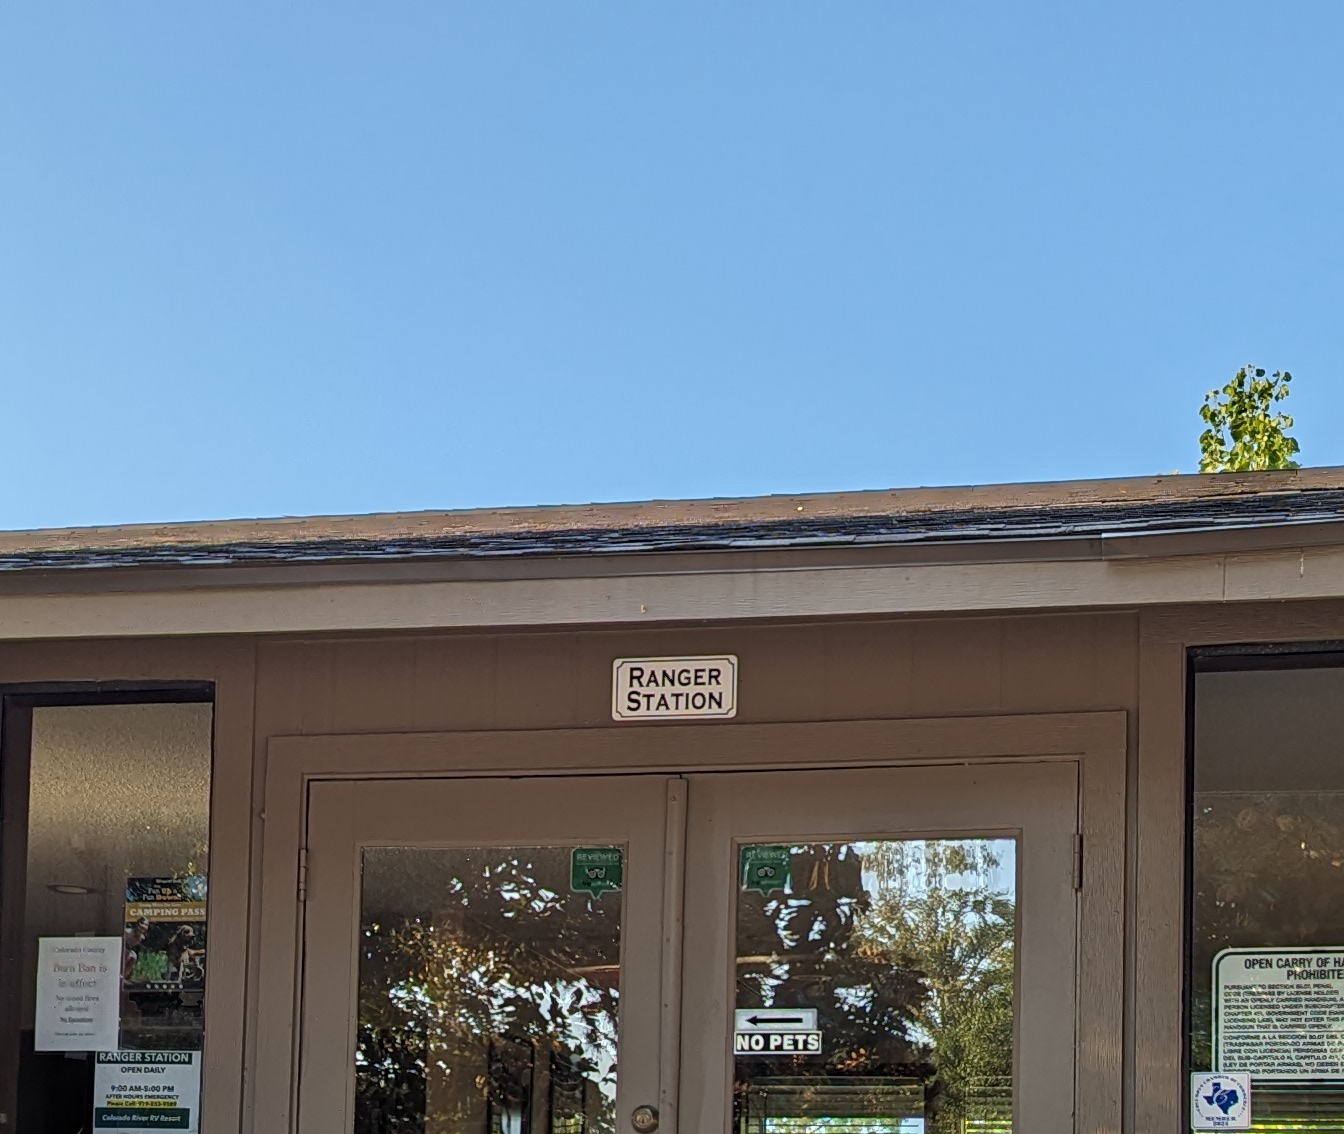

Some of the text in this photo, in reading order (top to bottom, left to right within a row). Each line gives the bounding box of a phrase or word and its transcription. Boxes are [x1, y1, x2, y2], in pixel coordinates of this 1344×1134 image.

[629, 667, 721, 688] RANGER
[627, 691, 723, 711] STATION
[129, 908, 206, 917] CAMPING PASS
[78, 963, 96, 973] Ban
[99, 963, 108, 973] is
[1244, 958, 1273, 969] OPEN
[1276, 957, 1313, 968] CARRY
[1316, 957, 1330, 968] OF
[736, 1034, 819, 1051] NO PETS
[99, 1052, 189, 1063] RANGER STATION
[120, 1066, 166, 1074] OPEN DAILY
[162, 1085, 175, 1093] PM
